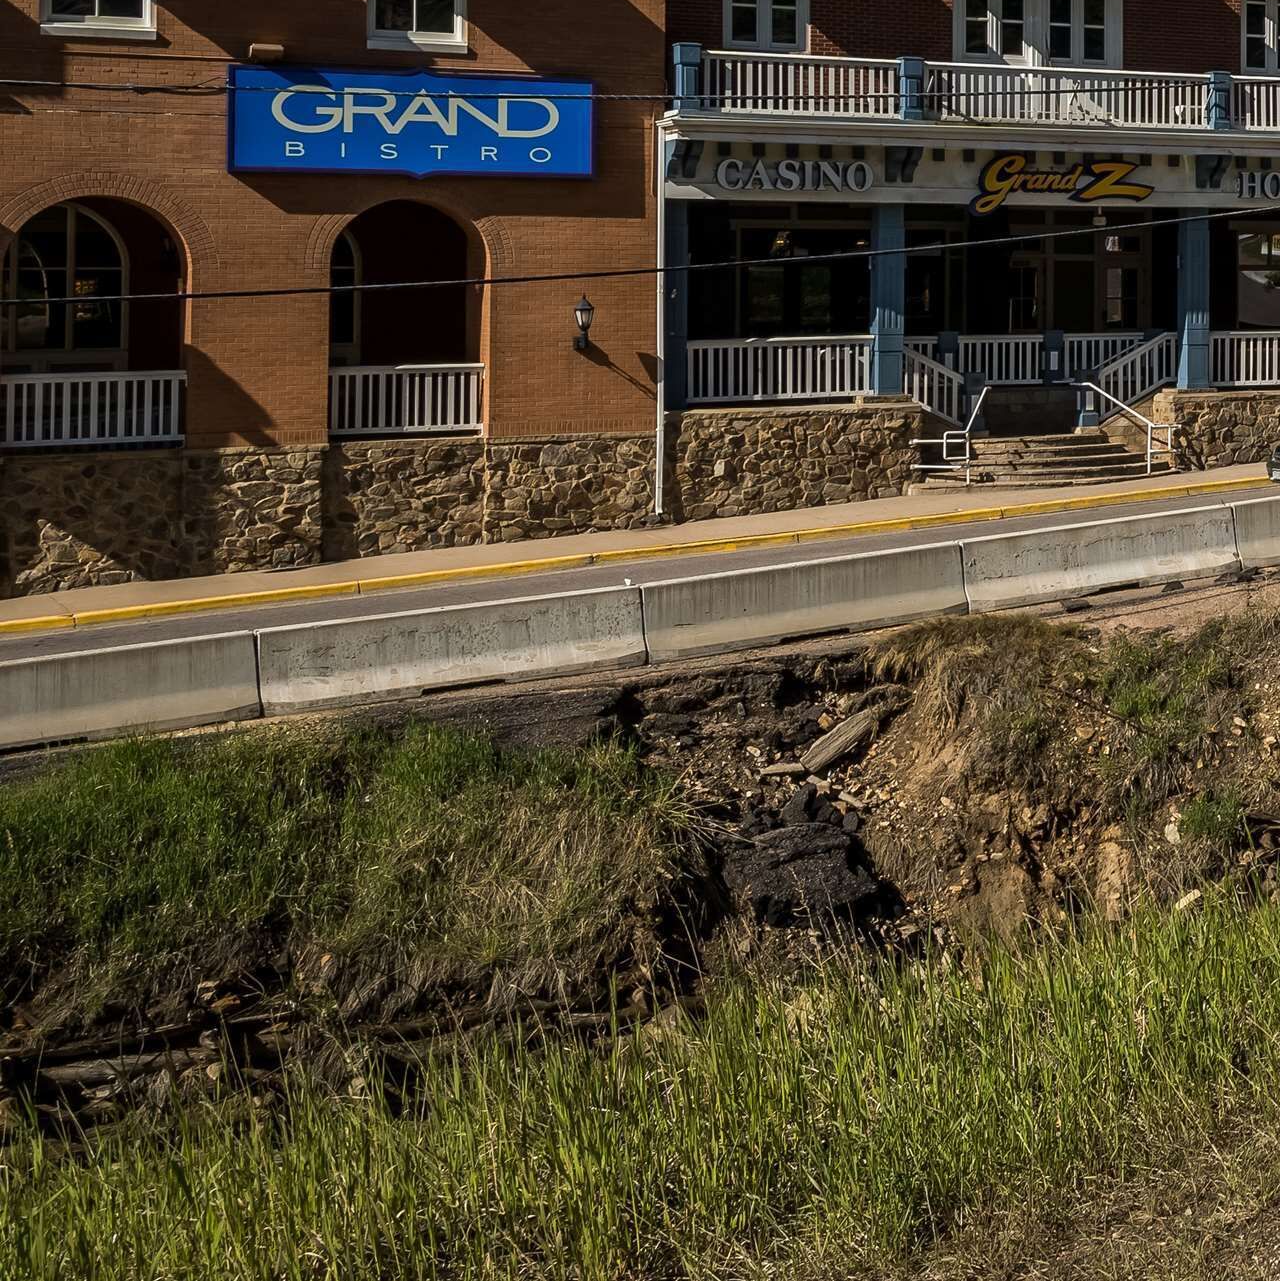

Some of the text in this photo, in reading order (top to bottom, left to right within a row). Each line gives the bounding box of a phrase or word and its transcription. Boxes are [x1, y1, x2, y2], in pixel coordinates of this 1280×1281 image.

[271, 84, 560, 138] GRAND
[285, 140, 552, 163] BISTRO
[717, 158, 873, 192] CASINO
[975, 154, 1154, 213] Grand Z
